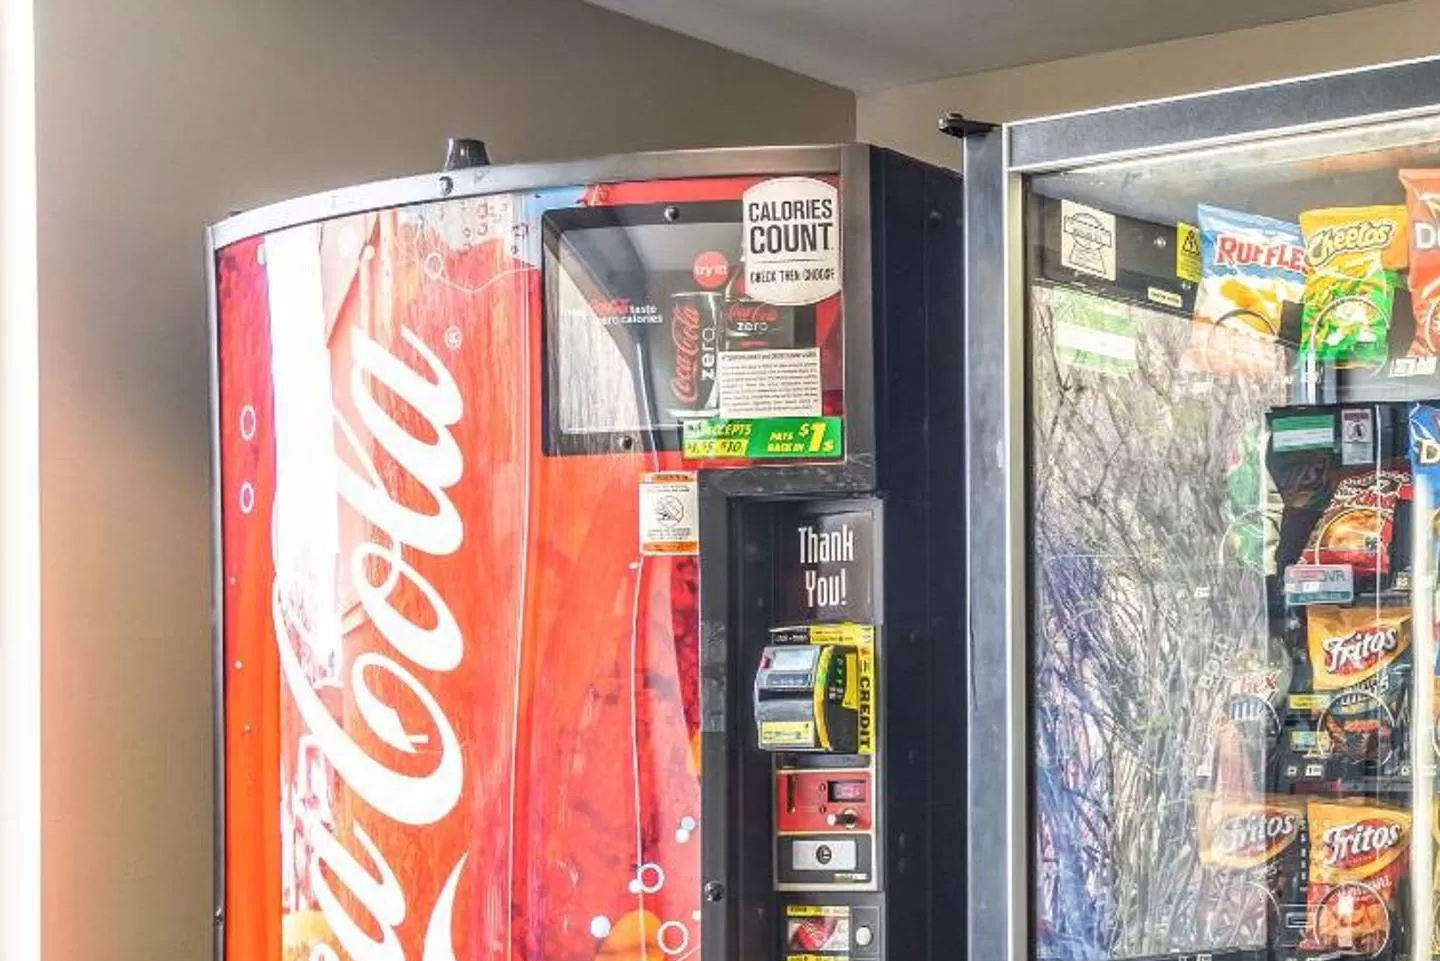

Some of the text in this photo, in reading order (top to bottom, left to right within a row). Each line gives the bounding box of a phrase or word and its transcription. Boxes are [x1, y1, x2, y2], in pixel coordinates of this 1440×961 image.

[748, 198, 833, 222] CALORIES
[750, 222, 833, 254] COUNT
[1307, 222, 1395, 267] Cheetos
[736, 321, 769, 332] zero
[701, 327, 716, 381] zero
[798, 523, 854, 564] Thank
[805, 567, 848, 608] You!
[1321, 625, 1399, 675] Fritos
[858, 675, 872, 749] CREDIT
[1321, 821, 1401, 866] Fritos
